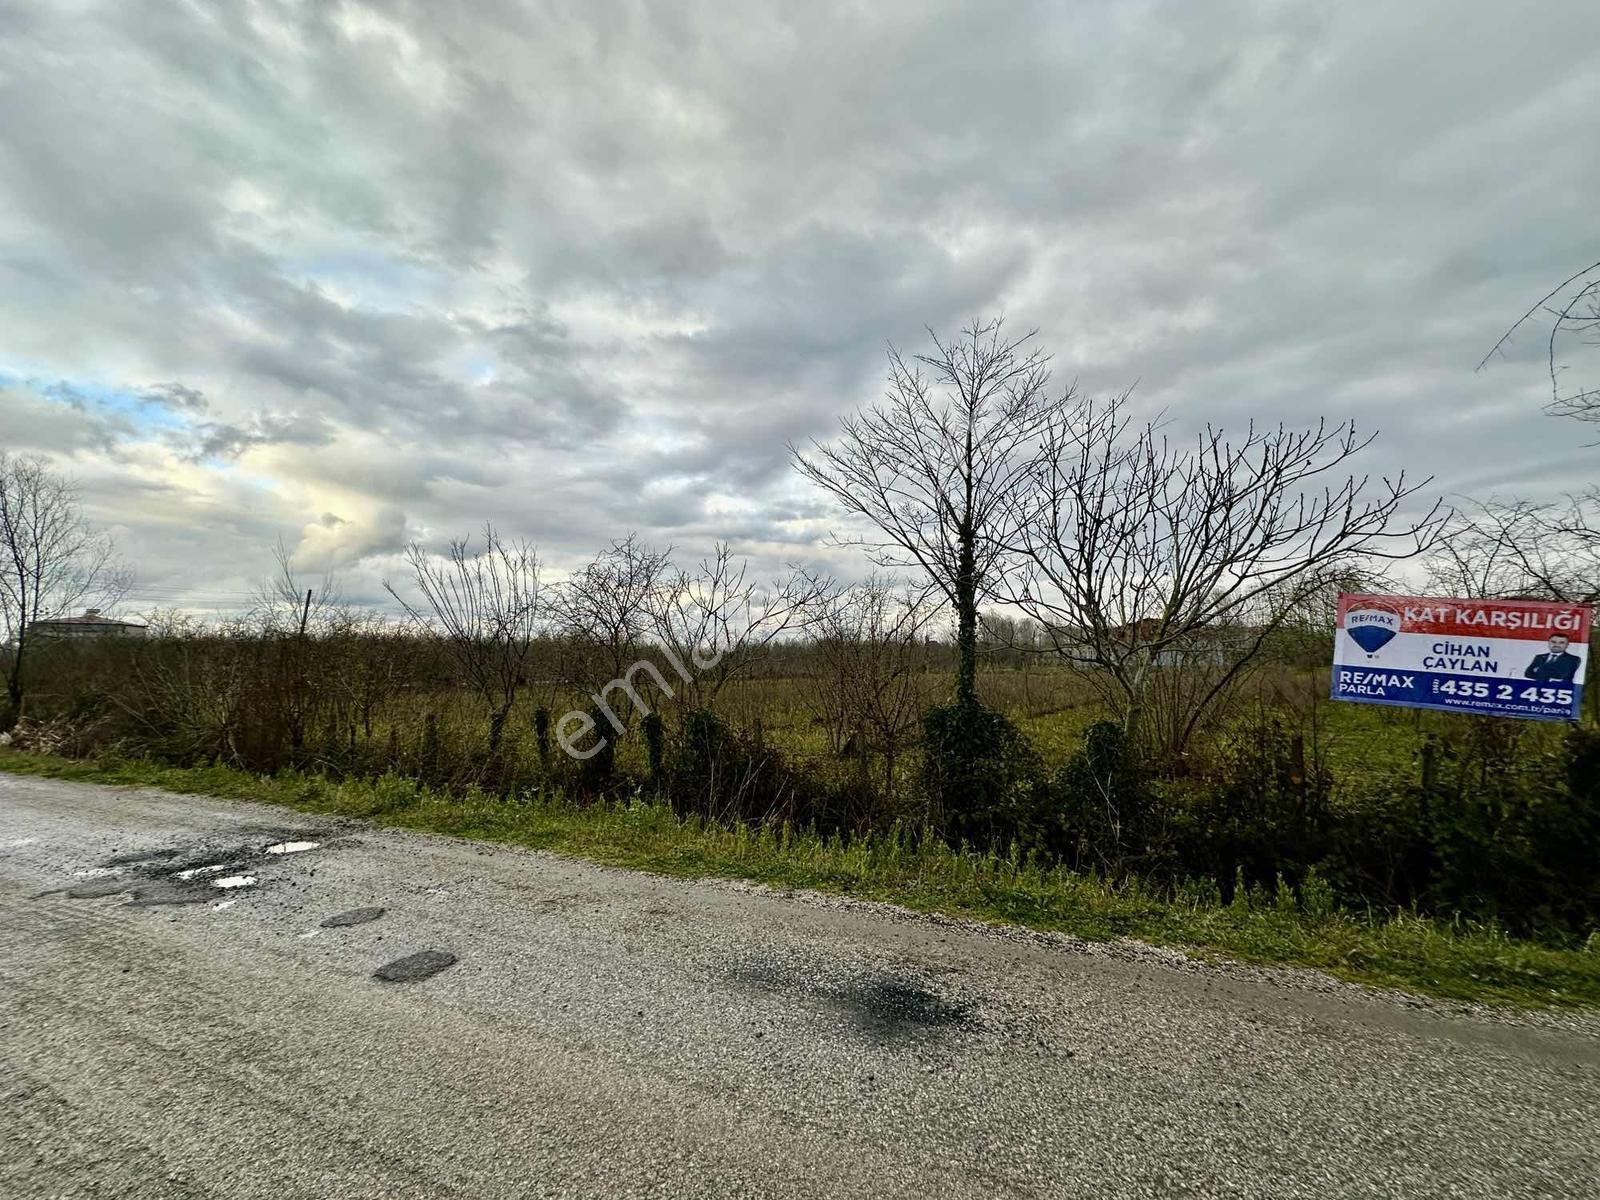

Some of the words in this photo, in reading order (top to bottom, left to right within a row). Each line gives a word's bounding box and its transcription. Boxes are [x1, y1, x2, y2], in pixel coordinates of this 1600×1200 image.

[1351, 614, 1393, 626] RE/MAX
[1404, 607, 1449, 623] KAT
[1455, 608, 1581, 631] KARŞILIĞI
[1432, 640, 1490, 658] CİHAN
[1423, 656, 1498, 673] ÇAYLAN
[1339, 671, 1414, 689] RE/MAX
[1339, 683, 1386, 696] PARLA
[1440, 679, 1489, 698] 435
[1496, 684, 1514, 700] 2
[1520, 687, 1573, 705] 435
